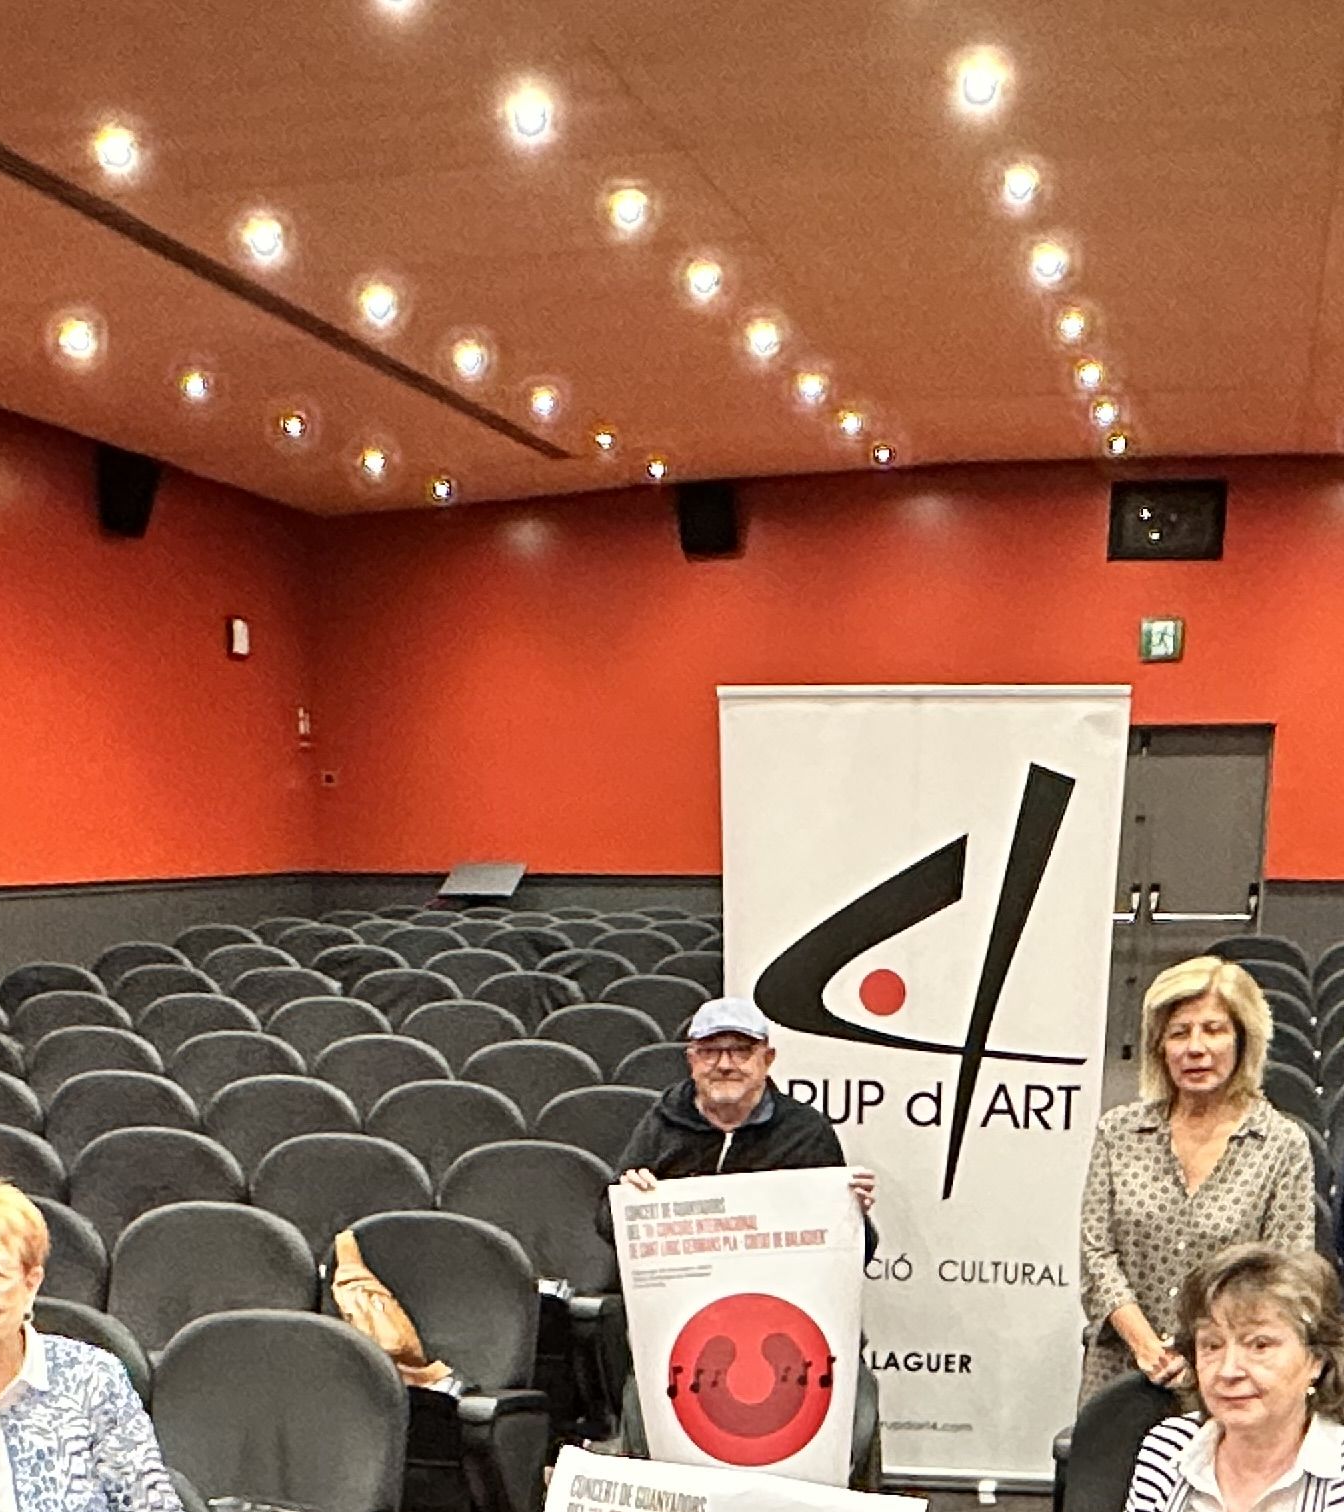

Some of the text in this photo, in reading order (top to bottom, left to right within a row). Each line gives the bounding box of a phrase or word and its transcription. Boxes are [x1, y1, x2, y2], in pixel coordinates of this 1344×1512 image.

[788, 1079, 885, 1125] RUP
[863, 1253, 1069, 1287] CIÓ CULTURAL
[871, 1350, 972, 1374] LAGUER
[570, 1475, 619, 1504] CONCERT
[619, 1483, 633, 1506] DE
